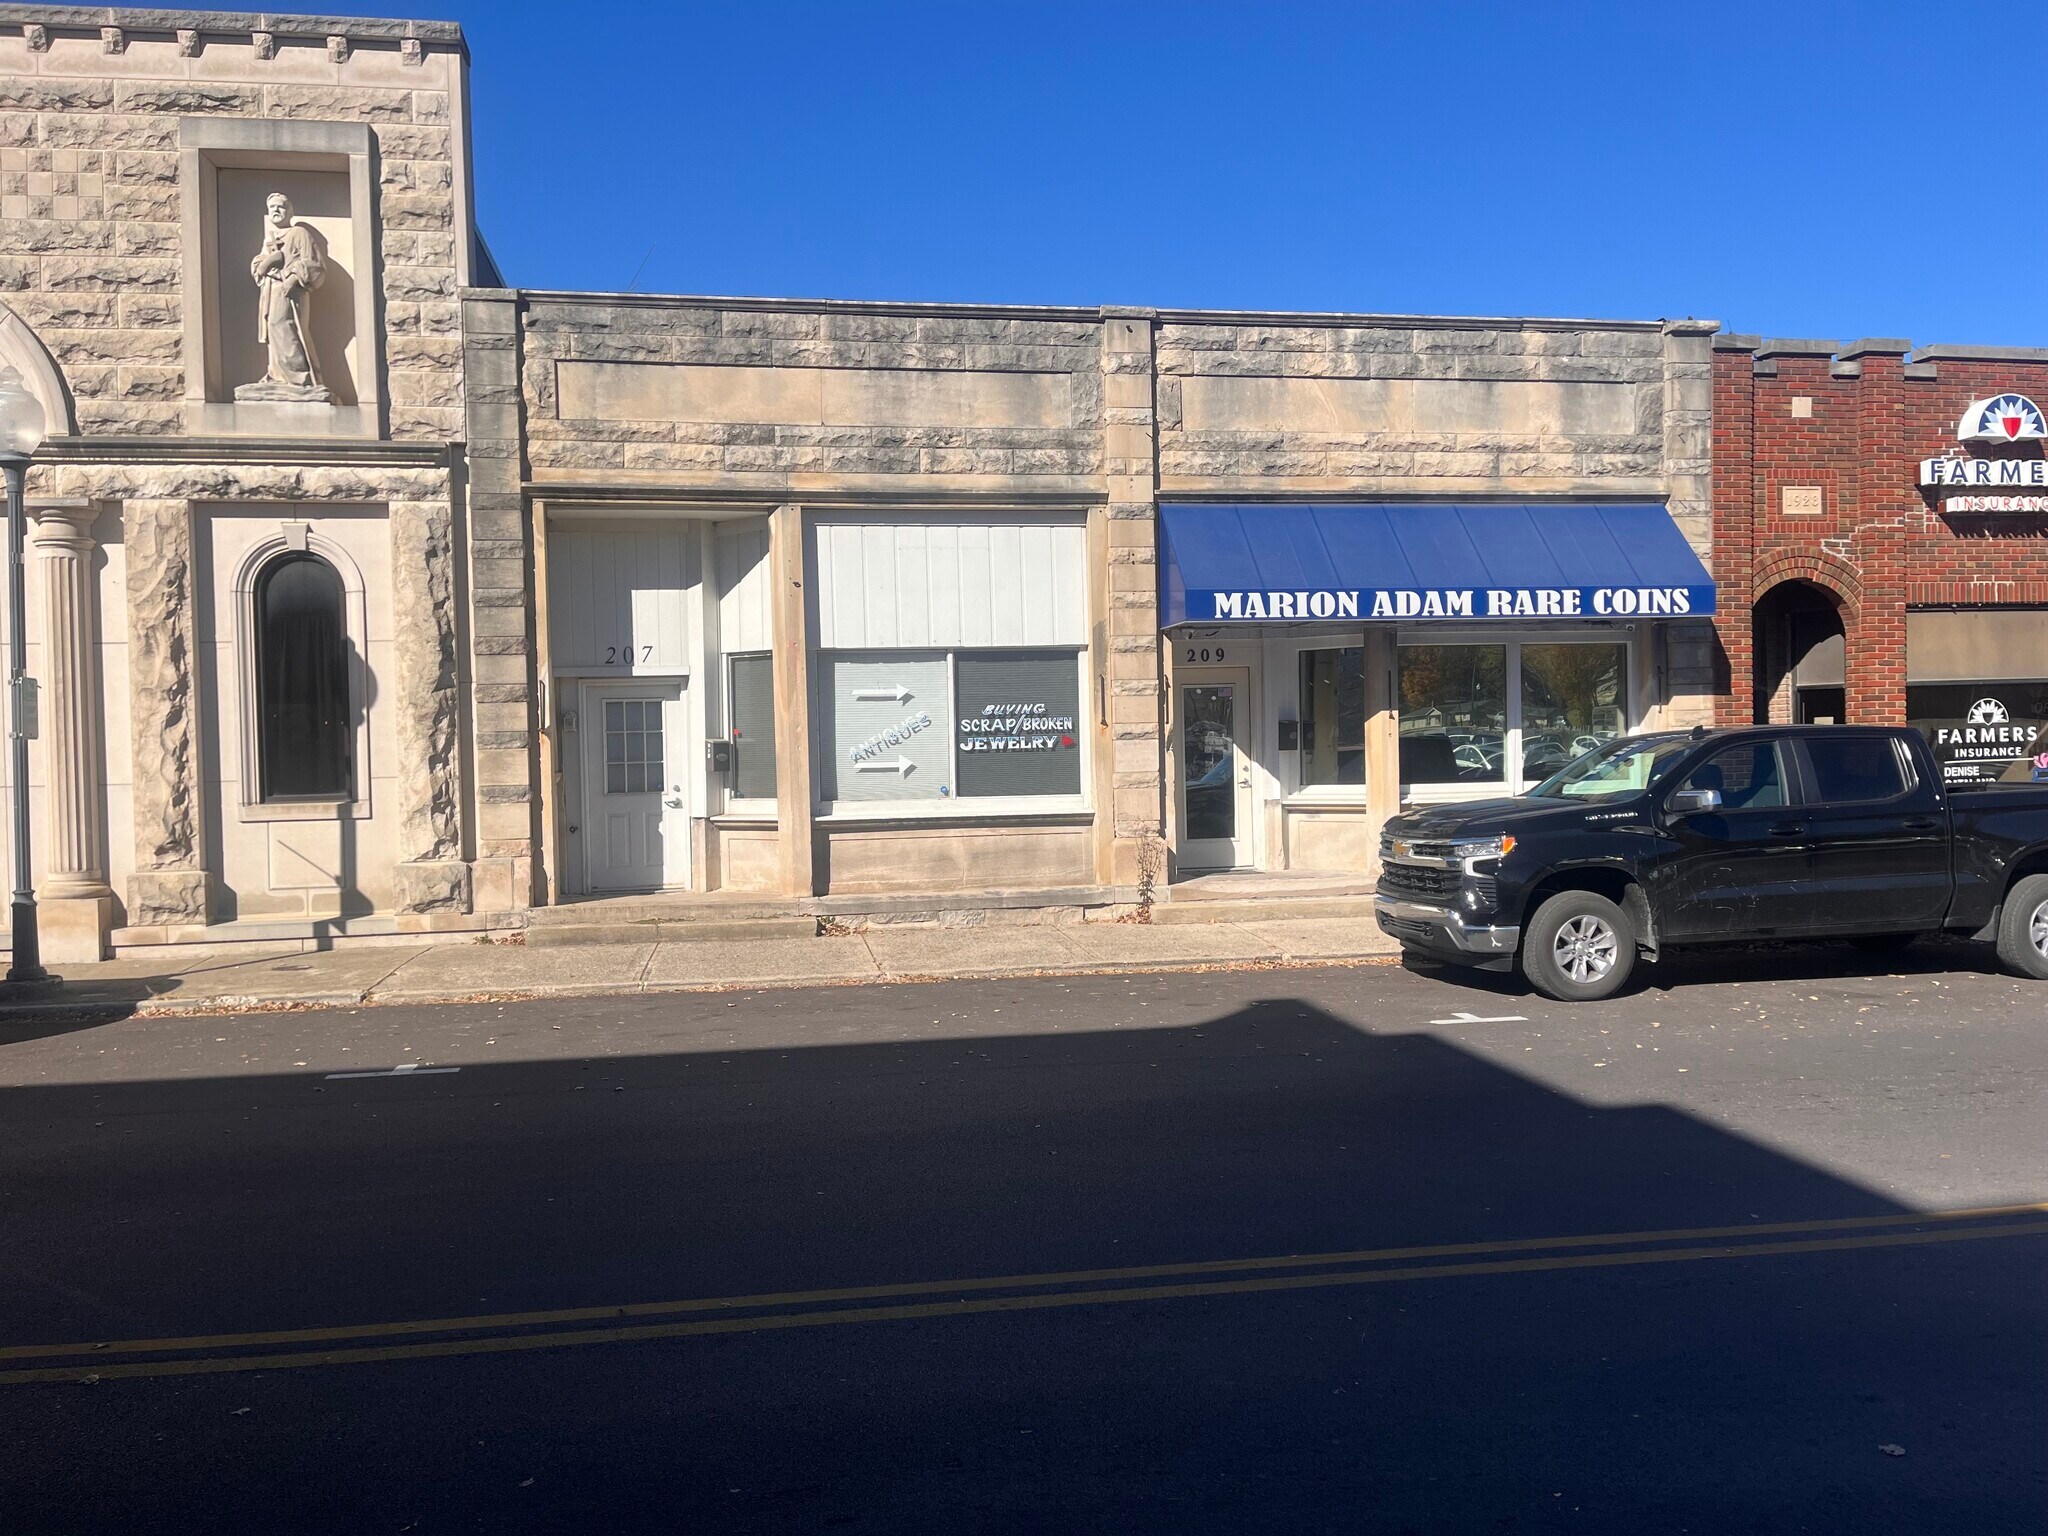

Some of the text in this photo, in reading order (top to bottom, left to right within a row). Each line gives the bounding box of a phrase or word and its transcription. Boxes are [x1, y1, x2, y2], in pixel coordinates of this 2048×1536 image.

[1213, 588, 1691, 619] MARION ADAM RARE COINS
[605, 646, 653, 664] 207
[1187, 648, 1225, 662] 209
[982, 703, 1046, 715] BUYING
[850, 711, 931, 763] ANTIQUES
[960, 735, 1058, 751] JEWELRY
[1938, 726, 2038, 745] FARMERS
[1955, 747, 2022, 758] INSURANCE
[1943, 766, 1980, 777] DENISE
